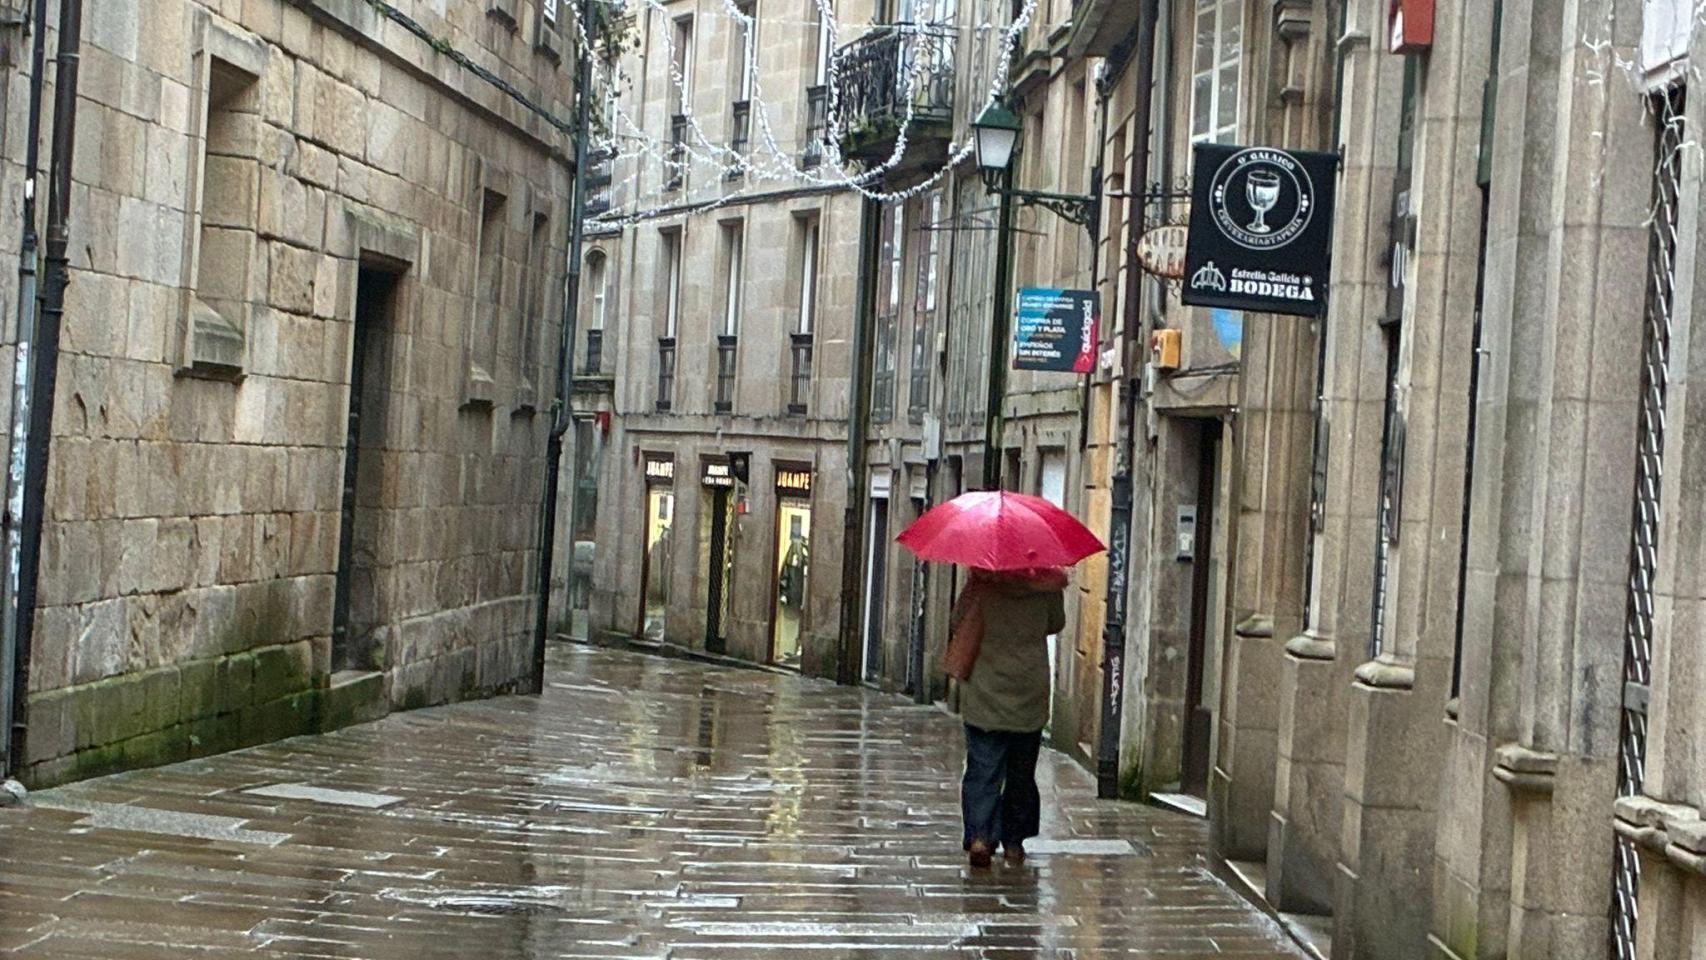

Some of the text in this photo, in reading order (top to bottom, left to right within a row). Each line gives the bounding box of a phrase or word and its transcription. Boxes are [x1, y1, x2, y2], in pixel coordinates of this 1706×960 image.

[1250, 151, 1295, 170] GALAICO
[1231, 268, 1300, 284] Estrella Galicia
[1229, 279, 1315, 301] BODEGA
[1043, 326, 1066, 334] PLATA
[777, 471, 811, 490] JUAMPE
